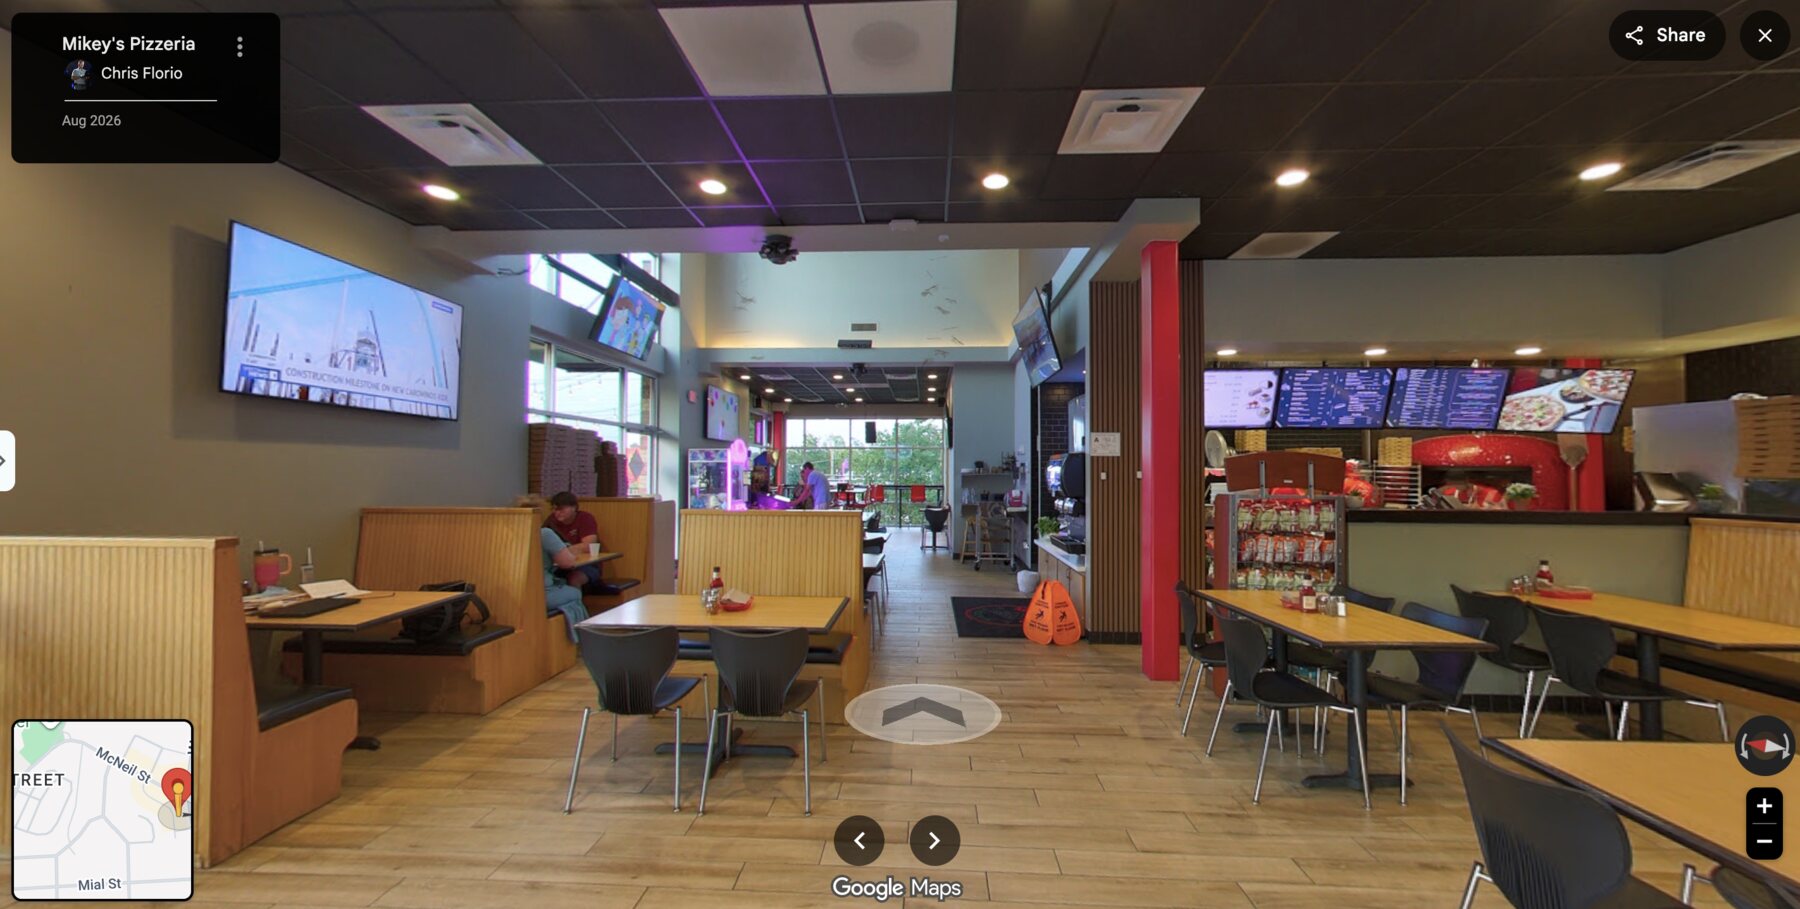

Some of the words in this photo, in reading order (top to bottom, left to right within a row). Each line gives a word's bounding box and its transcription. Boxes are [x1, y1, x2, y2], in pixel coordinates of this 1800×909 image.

[285, 367, 342, 384] CONSTRUCTION
[345, 377, 380, 390] MILESTONE
[381, 383, 390, 392] ON
